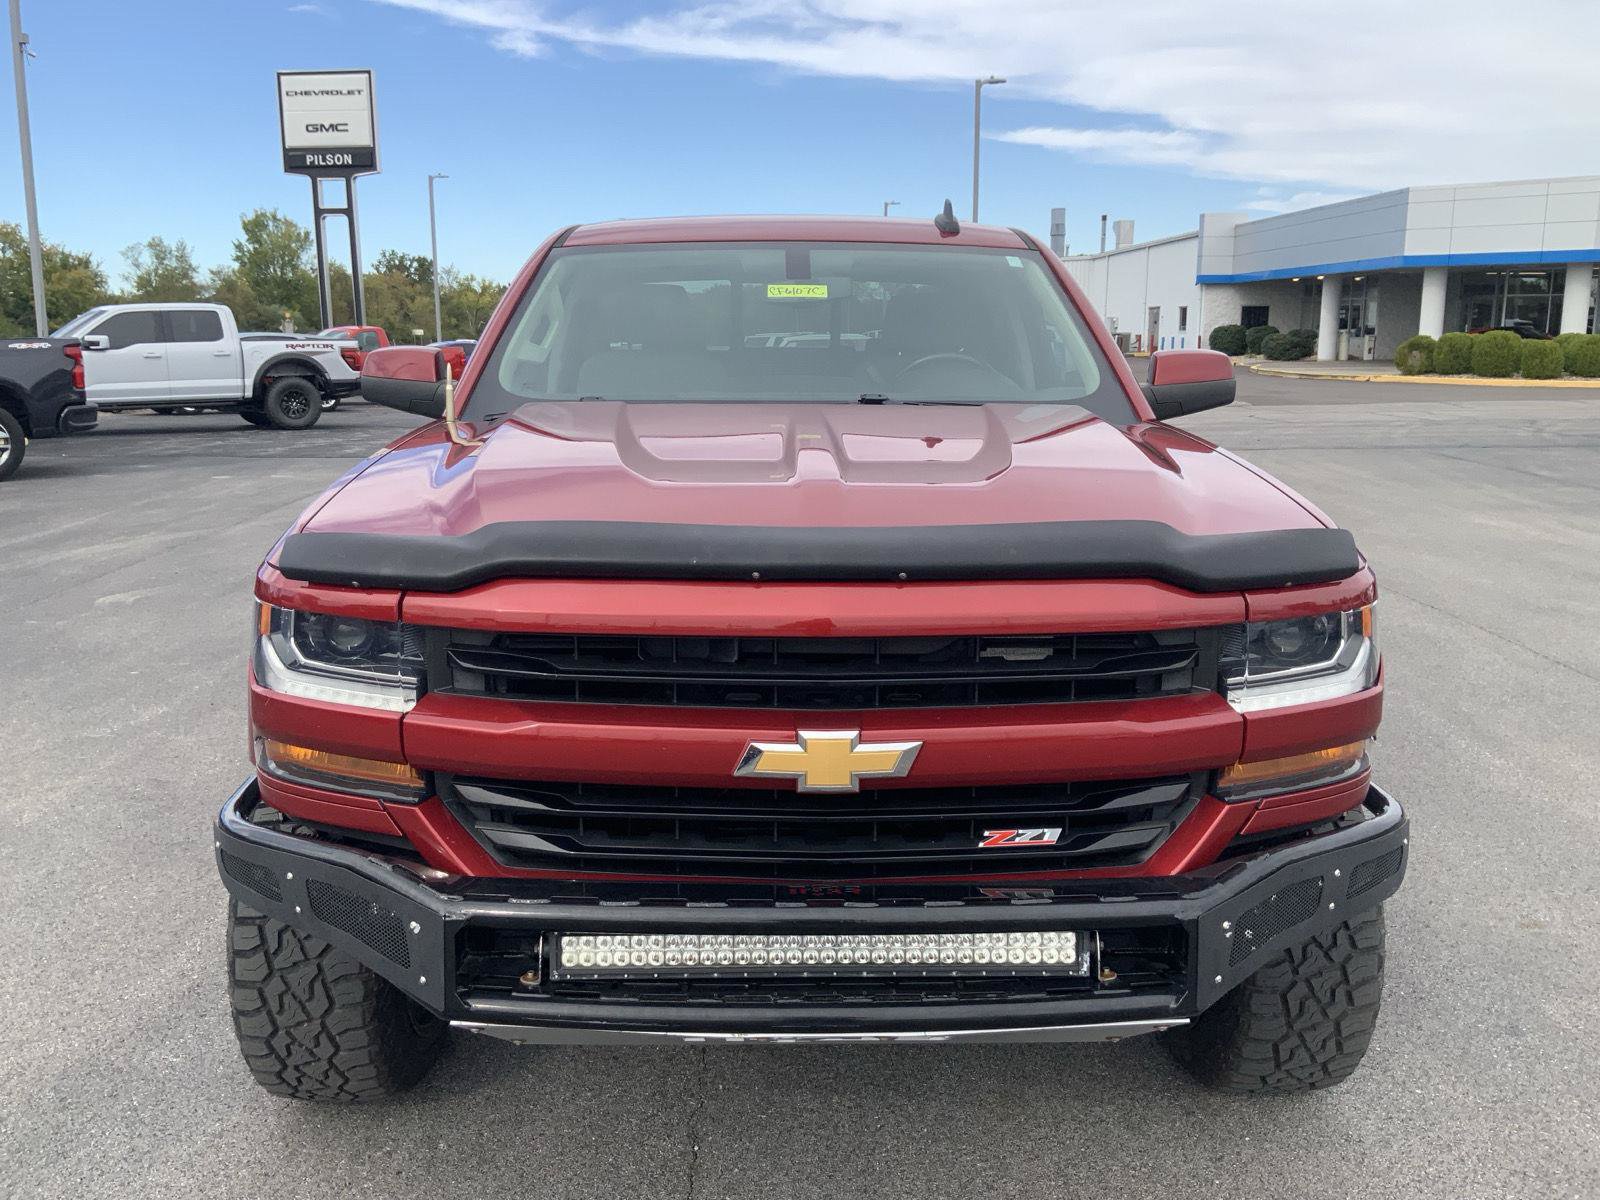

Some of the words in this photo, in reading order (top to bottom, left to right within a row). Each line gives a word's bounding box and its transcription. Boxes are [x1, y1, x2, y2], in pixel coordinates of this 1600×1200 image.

[285, 89, 364, 97] CHEVROLET
[305, 123, 349, 133] GMC
[306, 154, 352, 165] PILSON
[978, 828, 1063, 847] Z71
